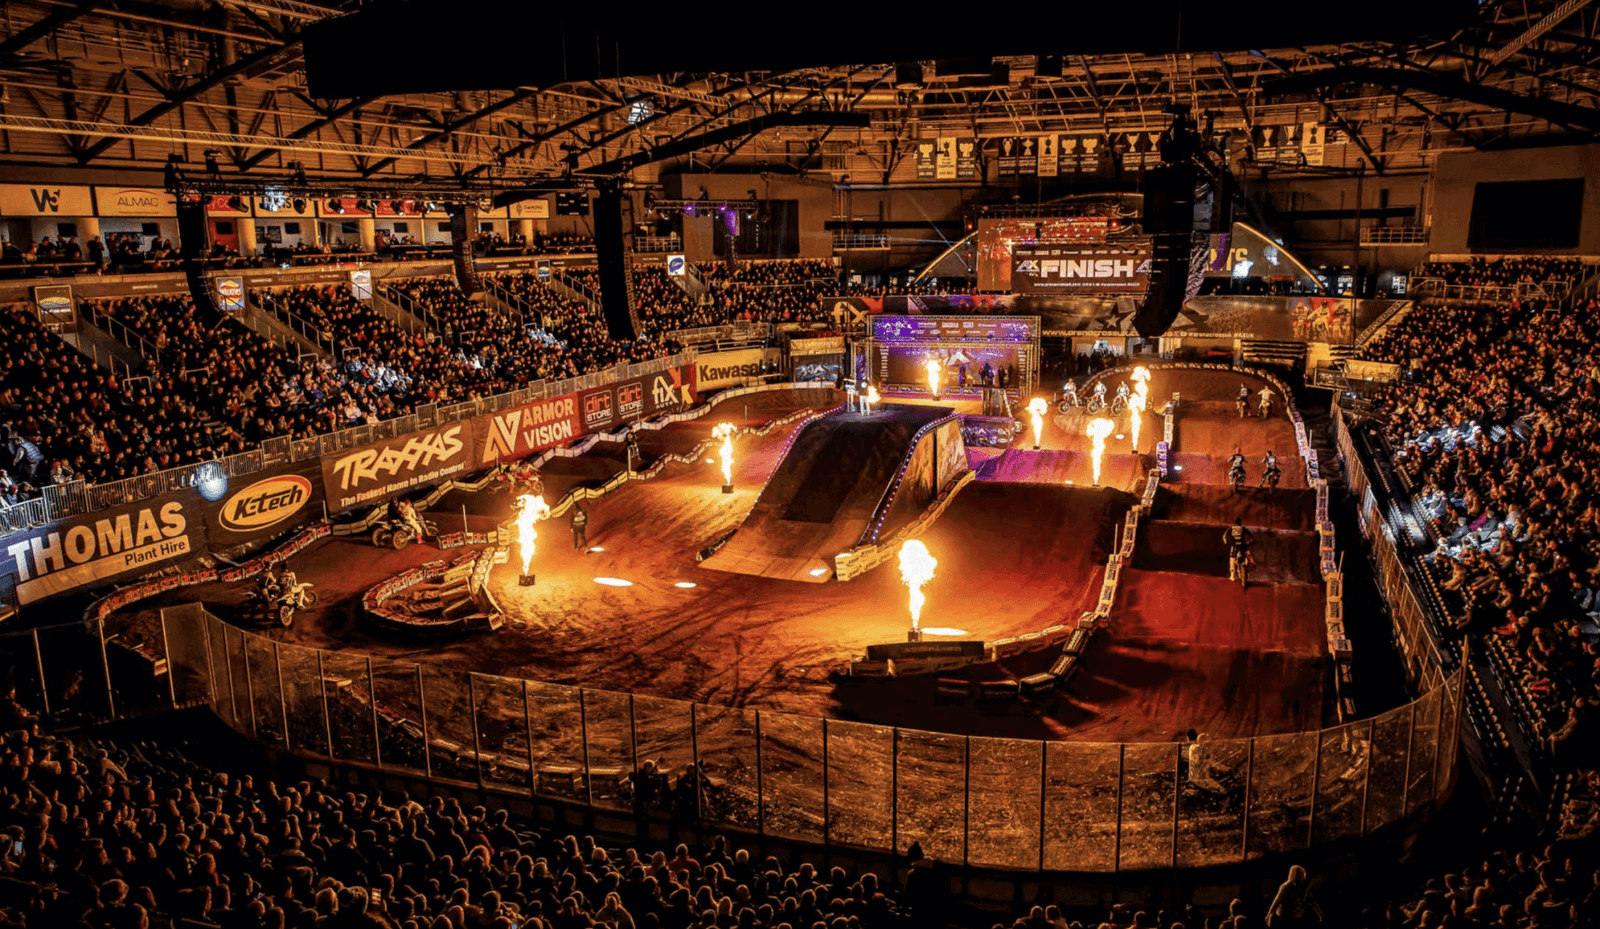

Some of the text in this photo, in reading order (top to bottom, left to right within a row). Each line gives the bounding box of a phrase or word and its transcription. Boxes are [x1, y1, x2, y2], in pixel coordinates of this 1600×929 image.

[118, 197, 159, 207] ALMAC
[1040, 259, 1134, 278] FINISH
[619, 385, 641, 404] dirt
[652, 376, 679, 405] fix
[523, 398, 574, 428] ARMOR
[586, 394, 610, 413] dirt
[586, 408, 612, 422] STORE
[620, 400, 642, 412] STORE
[523, 419, 573, 450] VISION
[332, 425, 464, 490] TRAXXAS
[340, 463, 465, 508] The Fastest Name In Radio Control
[7, 501, 187, 583] THOMAS
[125, 541, 186, 566] Plant Hire
